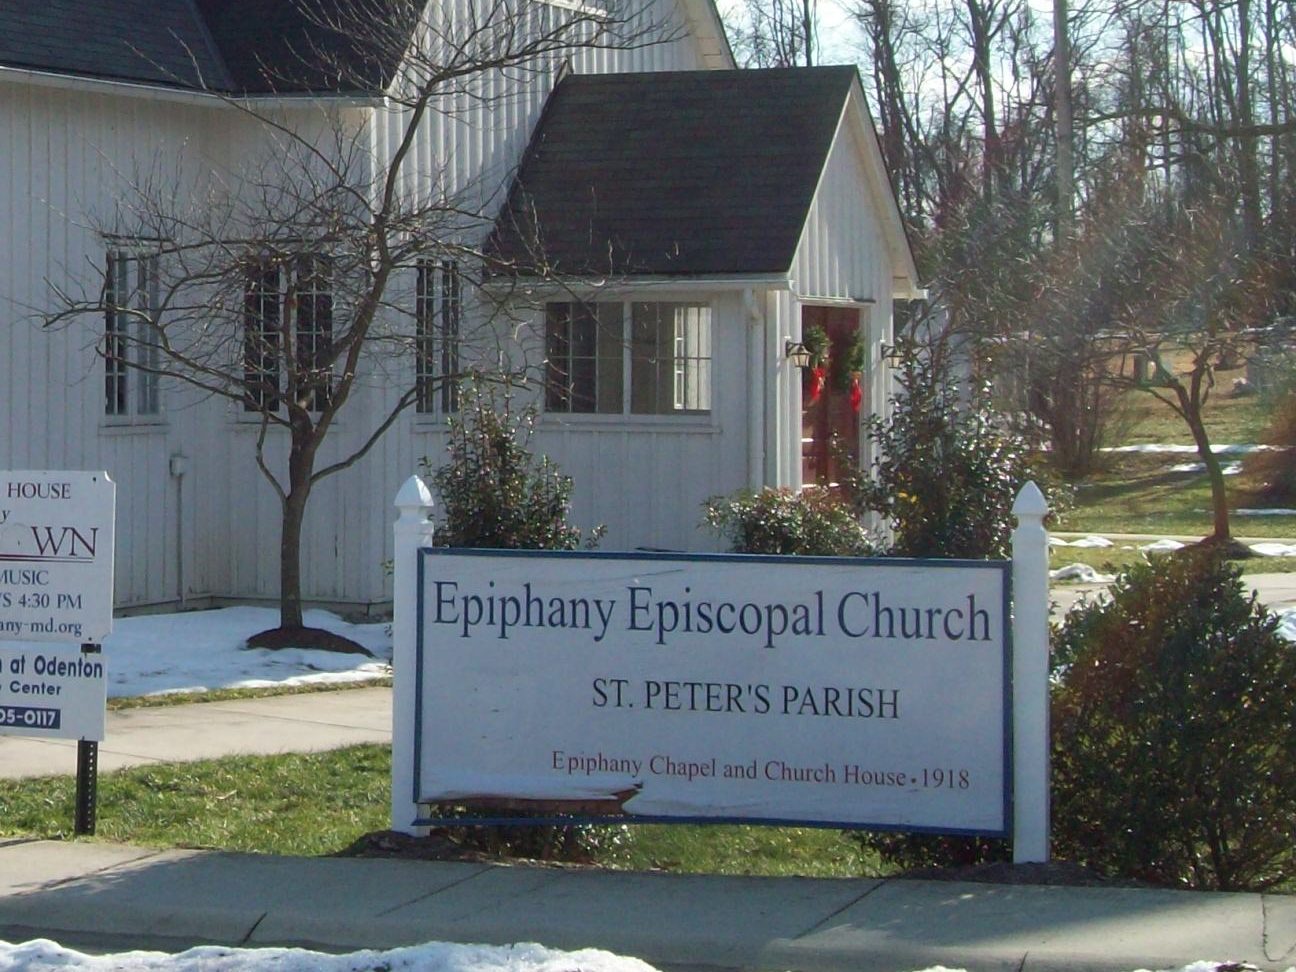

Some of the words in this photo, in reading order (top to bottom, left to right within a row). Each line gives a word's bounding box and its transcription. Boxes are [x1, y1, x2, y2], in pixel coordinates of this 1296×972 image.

[8, 482, 71, 499] HOUSE
[18, 593, 50, 608] 4:30
[57, 594, 82, 609] PM
[433, 581, 616, 642] Epiphany
[626, 586, 826, 648] Episcopal
[837, 591, 992, 641] Church
[10, 655, 25, 675] at
[34, 655, 103, 678] Odenton
[10, 680, 62, 696] Center
[592, 678, 634, 708] ST.
[644, 681, 770, 714] PETER'S
[781, 686, 900, 719] PARISH
[552, 750, 642, 778] Epiphany
[649, 755, 716, 781] Chapel
[723, 759, 757, 779] and
[764, 761, 836, 783] Church
[843, 765, 905, 787] House
[921, 768, 970, 789] 1918
